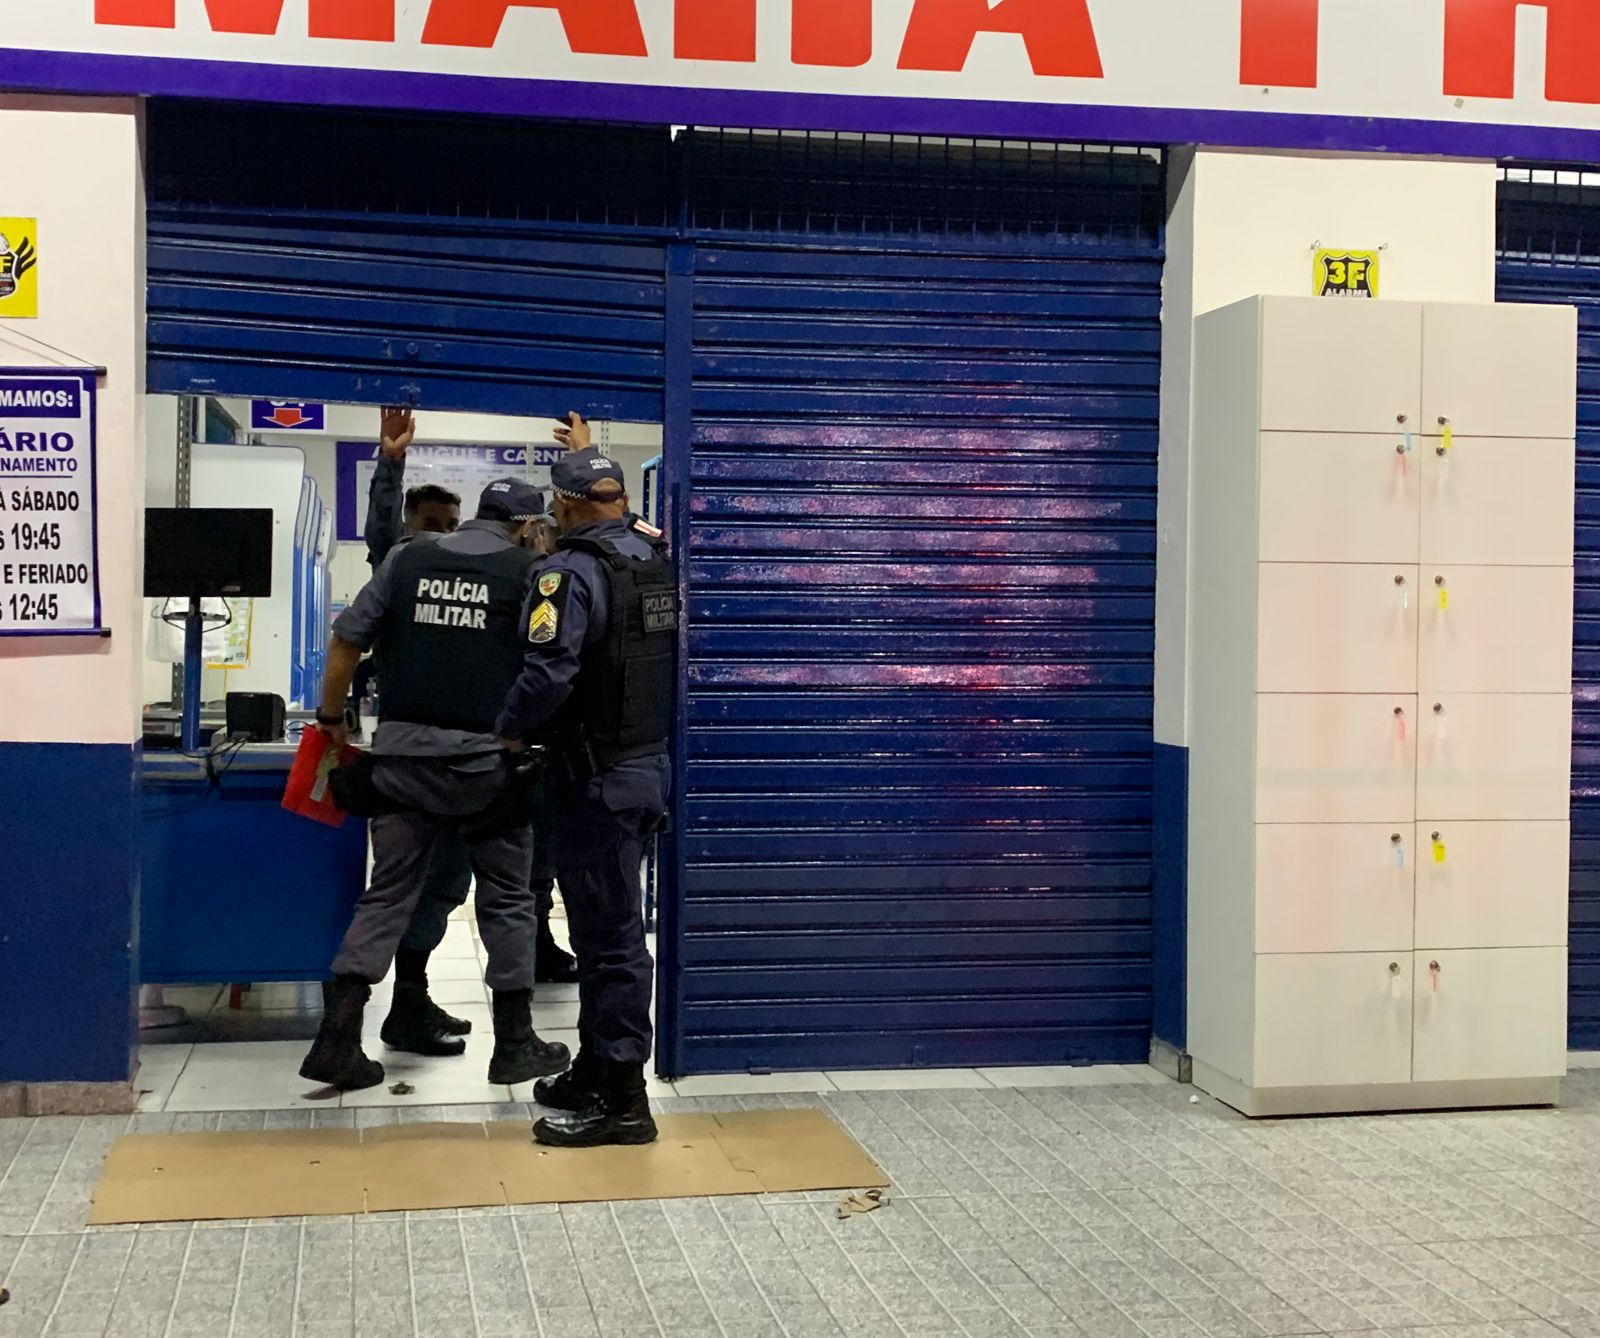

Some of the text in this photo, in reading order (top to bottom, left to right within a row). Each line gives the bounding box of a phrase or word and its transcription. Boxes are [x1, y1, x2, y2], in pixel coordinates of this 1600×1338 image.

[1328, 261, 1365, 289] 3F
[0, 390, 73, 407] MAMOS:
[0, 427, 74, 452] ÁRIO
[0, 457, 78, 472] NAMENTO
[11, 486, 80, 511] SÁBADO
[11, 522, 61, 550] 19:45
[4, 563, 88, 584] E FERIADO
[417, 577, 489, 605] POLÍCIA
[9, 593, 58, 621] 12:45
[414, 603, 486, 629] MILITAR
